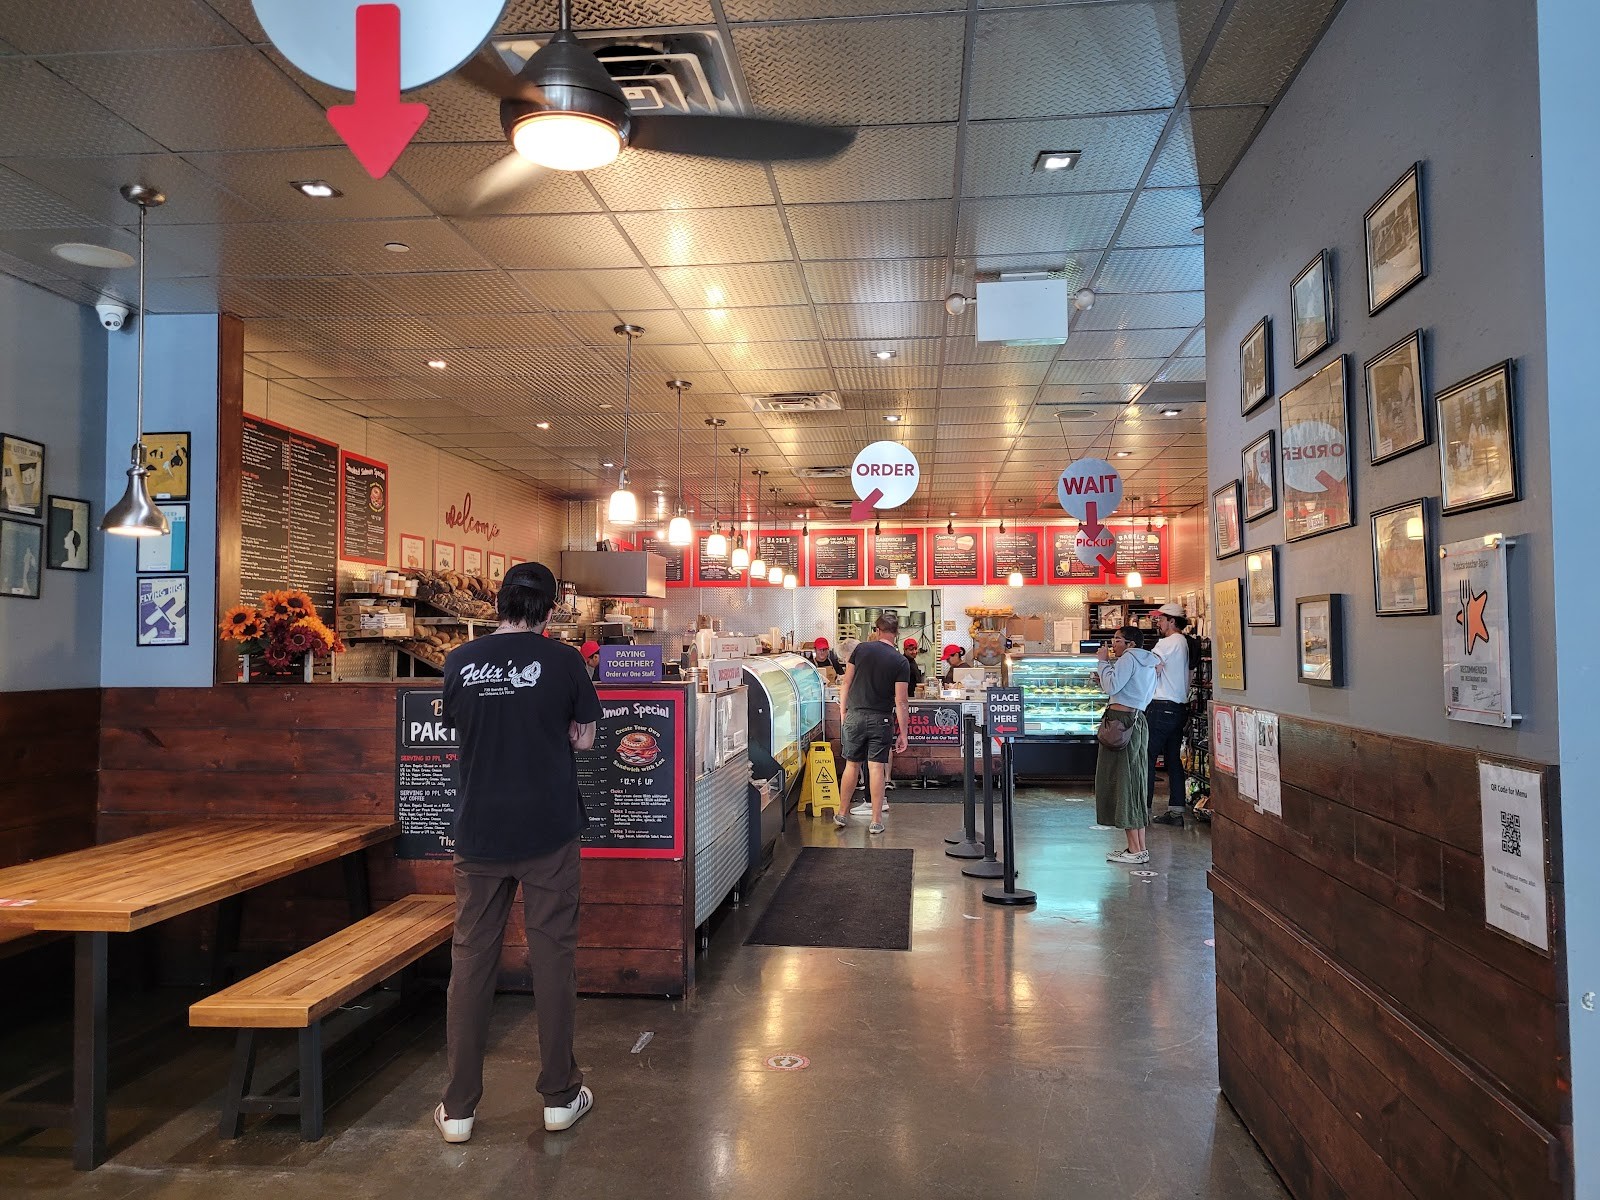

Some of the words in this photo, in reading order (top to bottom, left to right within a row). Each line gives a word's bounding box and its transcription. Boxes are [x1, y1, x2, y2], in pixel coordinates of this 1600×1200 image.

[856, 463, 915, 477] ORDER
[1063, 474, 1117, 495] WAIT
[446, 492, 500, 541] welcome
[1076, 538, 1115, 548] PICKUP
[140, 588, 169, 603] FLYING
[616, 650, 646, 658] PAYING
[607, 660, 655, 668] TOGETHER?
[460, 660, 517, 688] Felix's
[990, 694, 1020, 702] PLACE
[601, 706, 630, 720] lmon
[632, 702, 670, 719] Special
[989, 704, 1021, 712] ORDER
[993, 715, 1018, 723] HERE
[615, 726, 633, 735] Create
[648, 727, 661, 738] Own
[613, 760, 640, 772] Sandwich
[641, 764, 655, 772] with
[644, 778, 654, 786] UP
[1490, 783, 1497, 791] QR
[1498, 785, 1508, 794] Code
[1515, 789, 1528, 799] Menu
